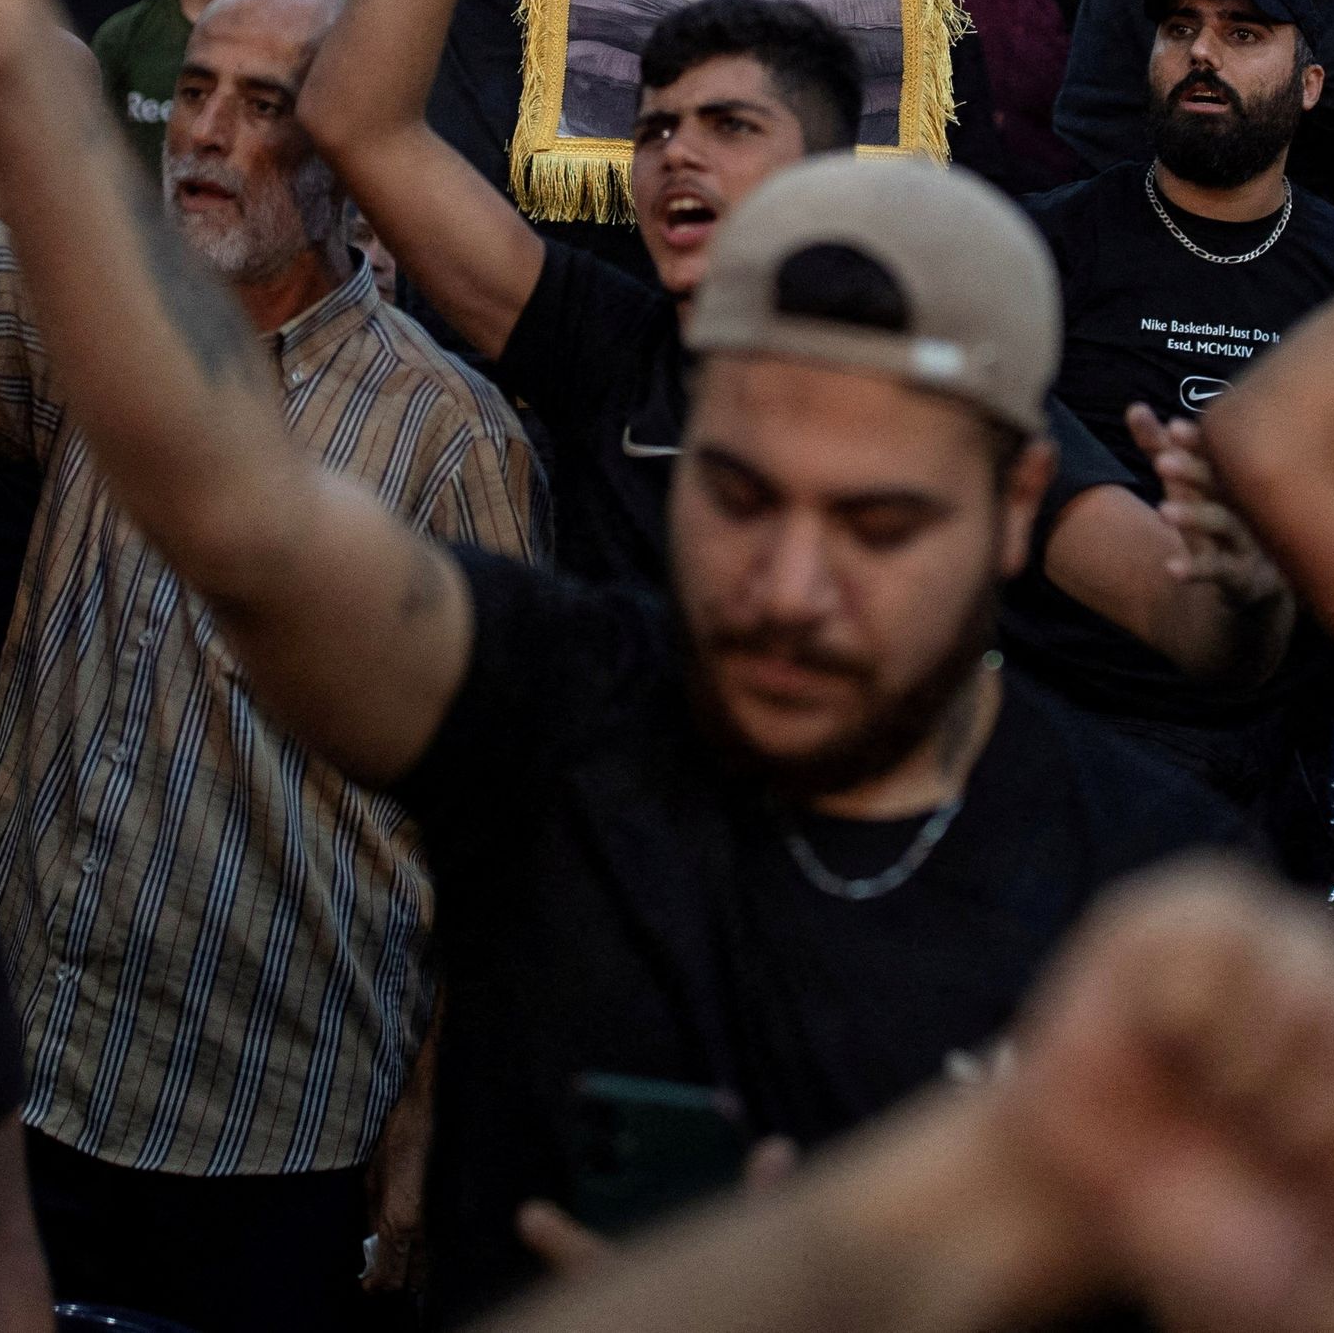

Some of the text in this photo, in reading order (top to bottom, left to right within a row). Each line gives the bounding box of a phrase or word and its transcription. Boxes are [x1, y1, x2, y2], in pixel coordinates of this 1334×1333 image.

[1141, 318, 1167, 332] Nike
[1171, 320, 1251, 340] Basketball-Just
[1253, 328, 1270, 343] Do
[1167, 338, 1254, 358] Estd. MCMLXIV
